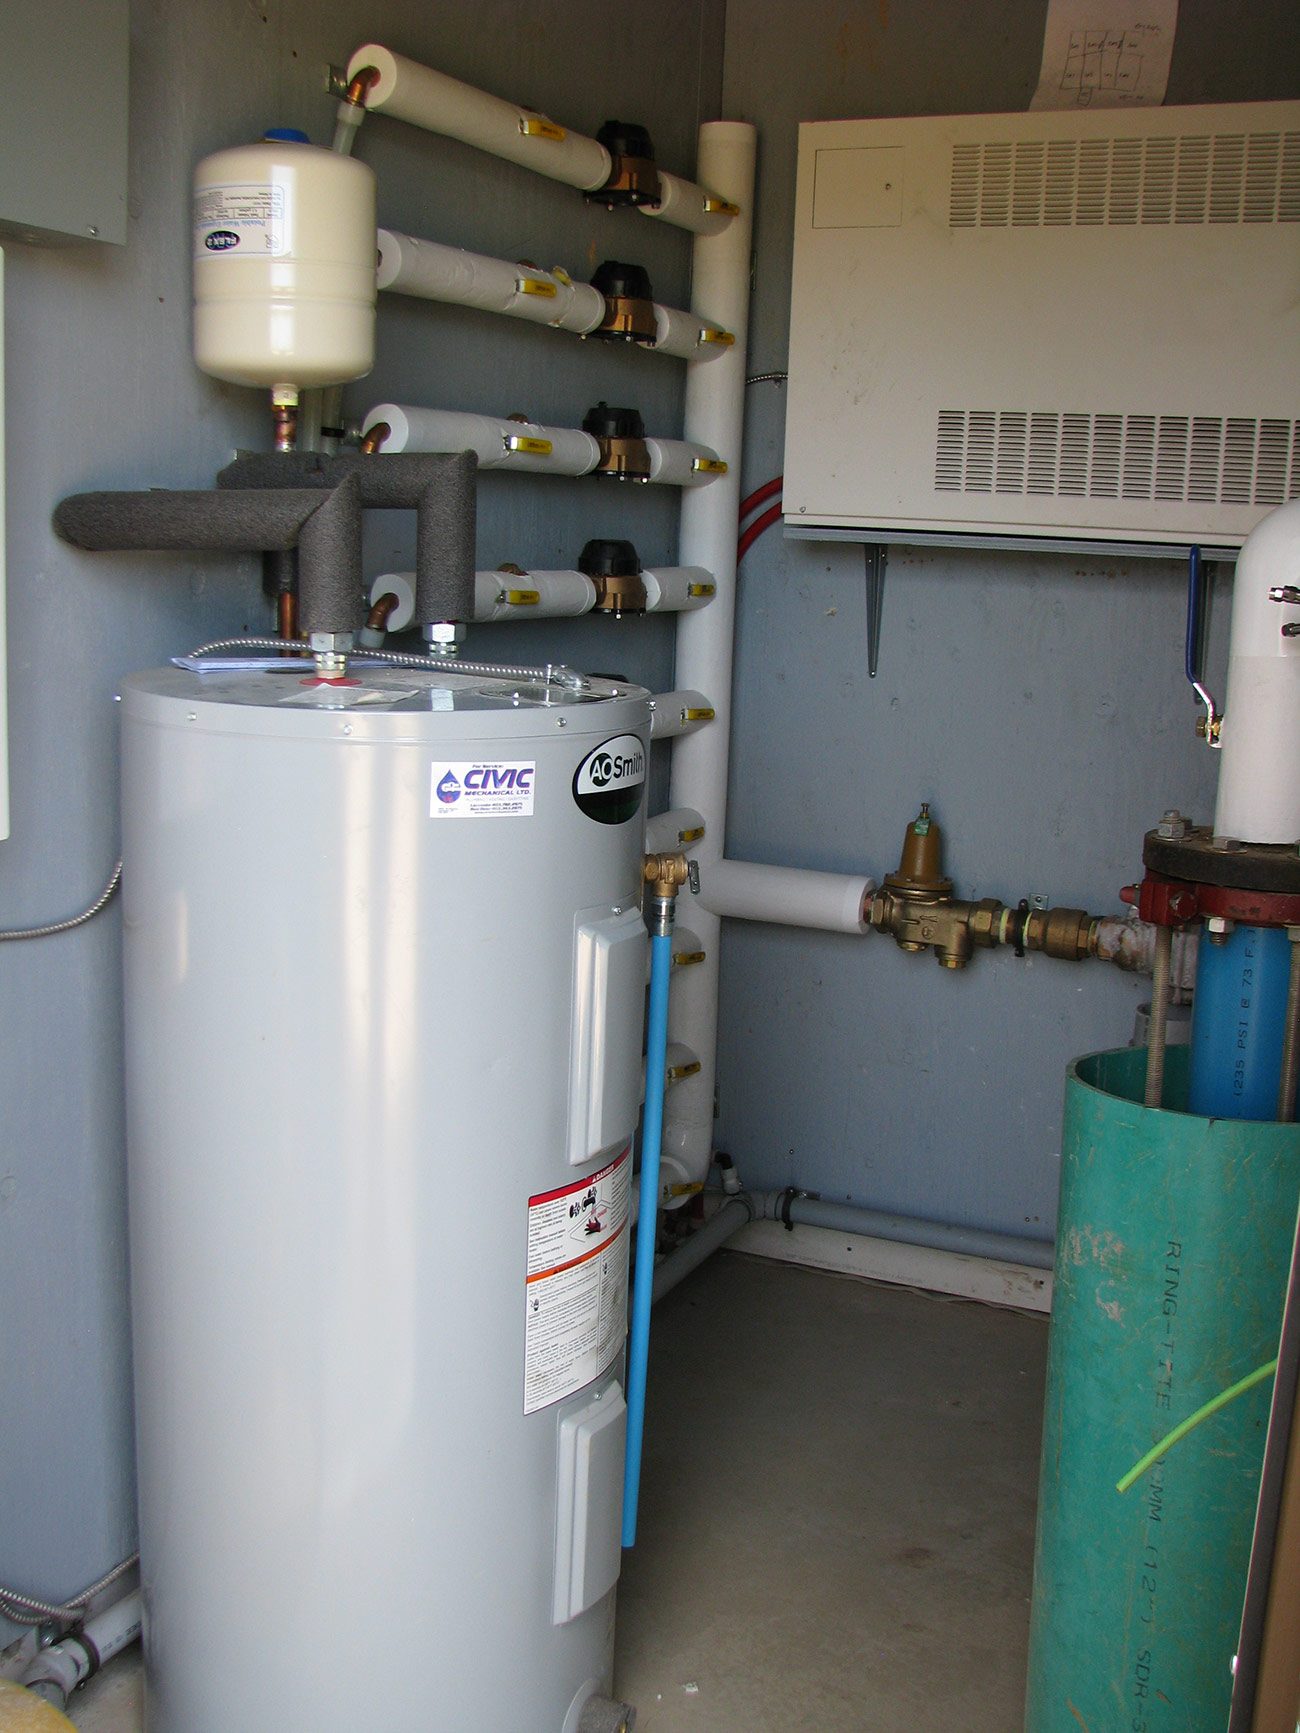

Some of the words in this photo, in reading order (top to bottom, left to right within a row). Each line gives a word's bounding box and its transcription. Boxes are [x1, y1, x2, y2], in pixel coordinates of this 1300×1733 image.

[463, 768, 534, 789] CIVIC
[1241, 968, 1253, 986] 73
[1237, 1021, 1249, 1050] PSI
[1155, 1240, 1182, 1411] RING-TITE
